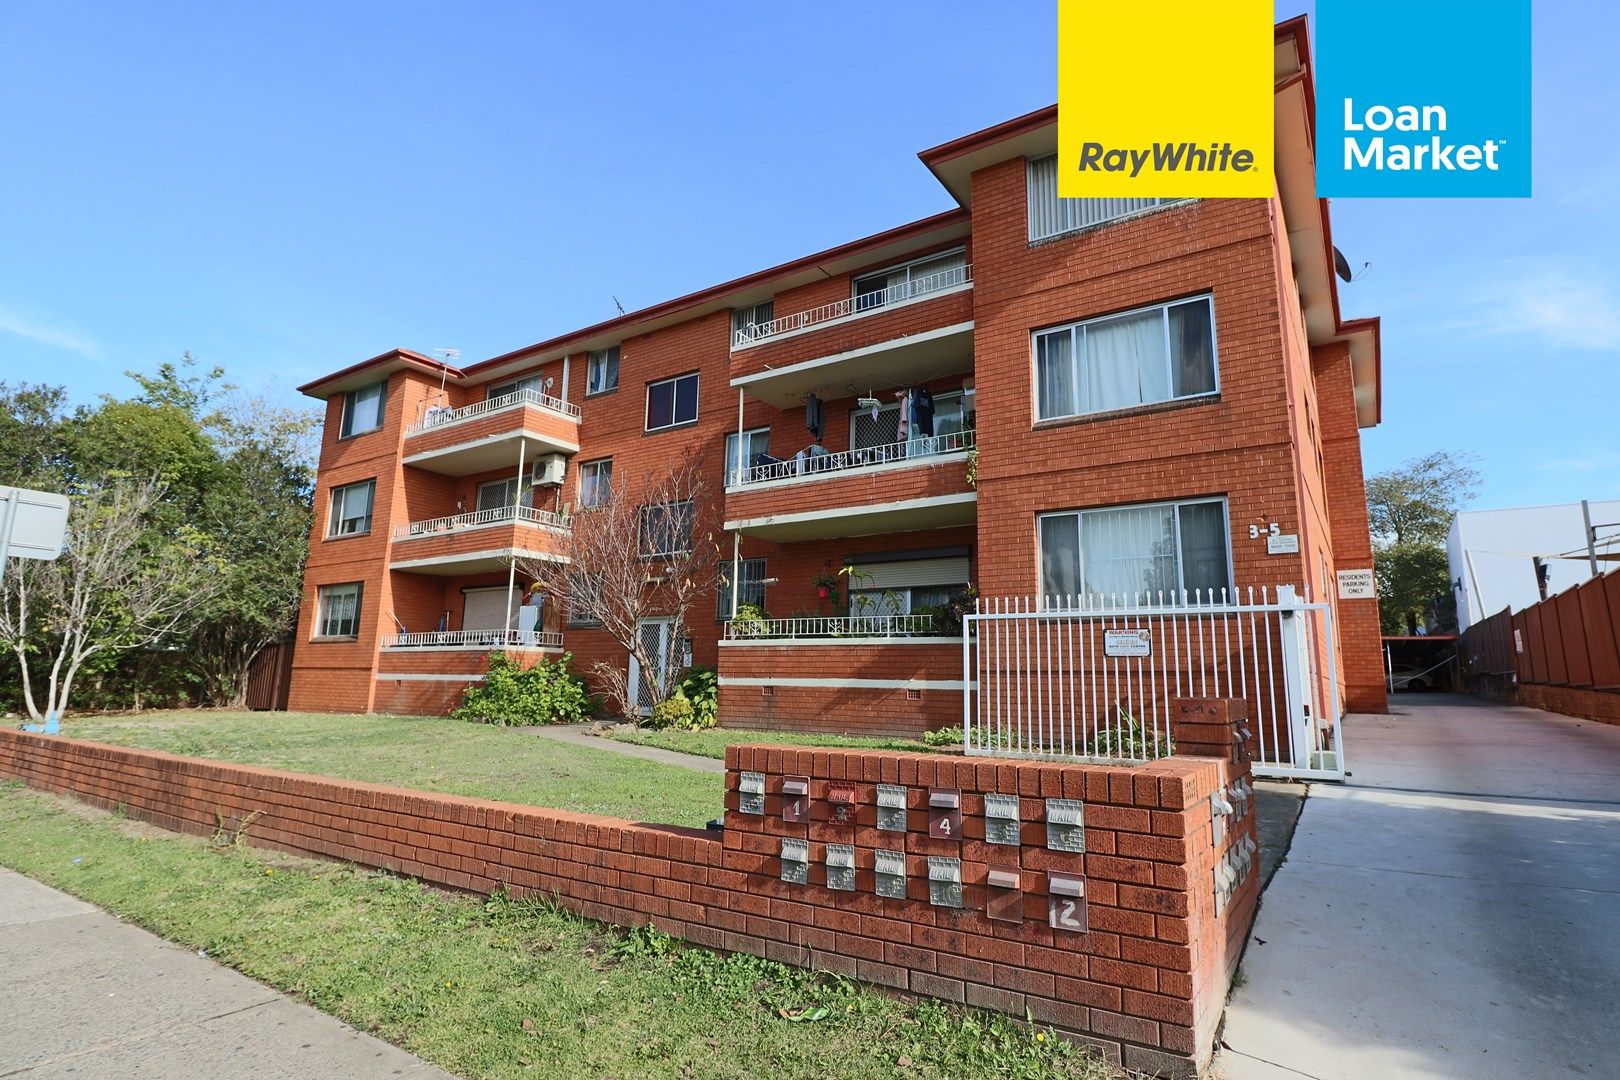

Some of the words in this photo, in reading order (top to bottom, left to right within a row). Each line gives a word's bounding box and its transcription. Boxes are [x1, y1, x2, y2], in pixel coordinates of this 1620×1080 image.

[1249, 523, 1280, 539] 3-5
[793, 802, 800, 816] 1
[939, 818, 951, 835] 4
[1049, 899, 1080, 928] 12
